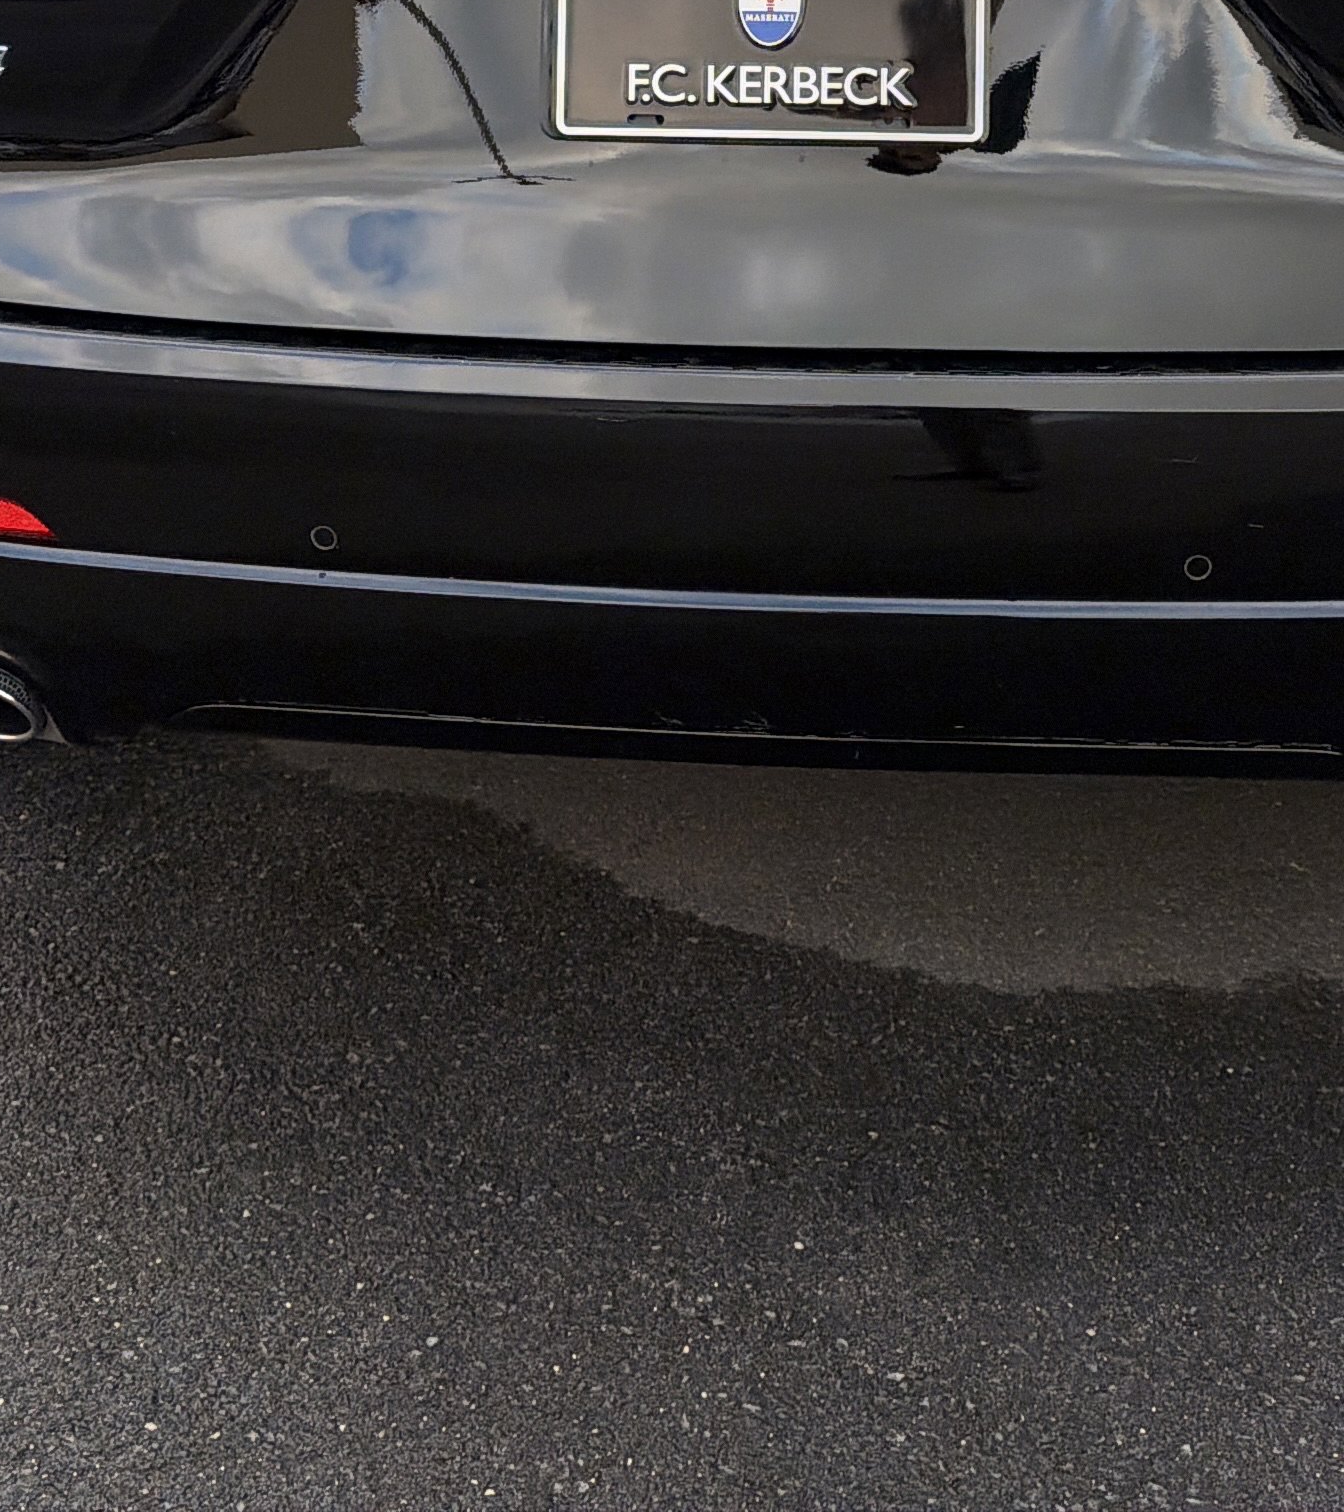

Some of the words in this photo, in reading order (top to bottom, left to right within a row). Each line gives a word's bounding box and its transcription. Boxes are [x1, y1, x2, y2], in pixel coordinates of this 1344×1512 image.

[745, 13, 795, 22] MASERATI
[628, 62, 697, 104] F.C.
[706, 64, 914, 107] KERBECK
